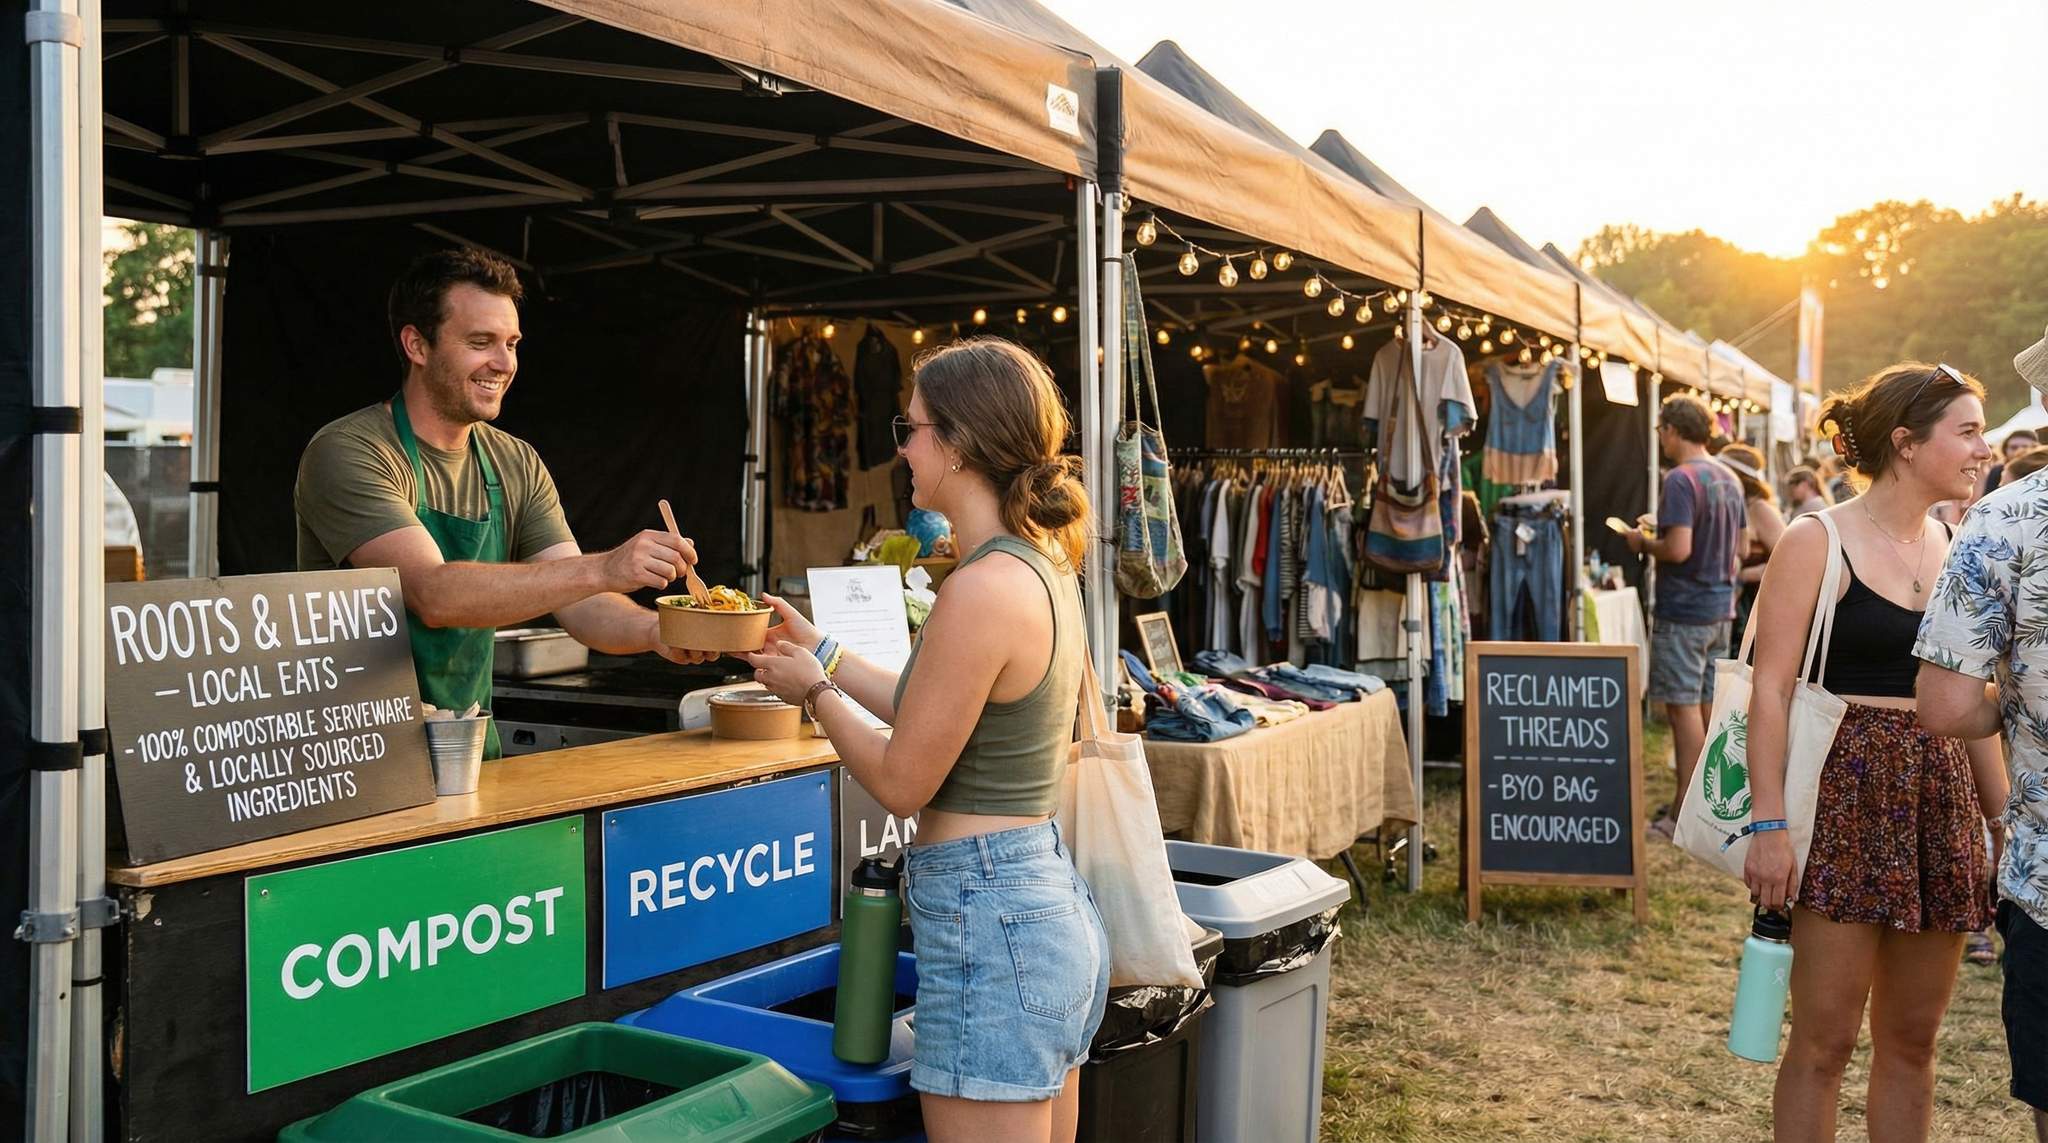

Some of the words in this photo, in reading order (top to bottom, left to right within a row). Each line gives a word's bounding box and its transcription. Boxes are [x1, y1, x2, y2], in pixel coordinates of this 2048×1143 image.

[110, 597, 241, 665] ROOTS
[251, 593, 282, 651] &
[287, 586, 398, 646] LEAVES
[187, 665, 272, 708] LOCAL
[277, 656, 338, 696] EATS
[1486, 672, 1621, 708] RECLAIMED
[193, 709, 318, 754] COMPOSTABLE
[322, 696, 414, 734] SERVEWARE
[1499, 716, 1610, 749] THREADS
[185, 762, 204, 794] &
[208, 747, 294, 790] LOCALLY
[302, 732, 385, 771] SOURCED
[1553, 775, 1600, 803] BAG
[227, 770, 357, 822] INGREDIENTS
[1490, 813, 1620, 844] ENCOURAGED
[630, 832, 815, 917] RECYCLE
[281, 886, 564, 999] COMPOST
